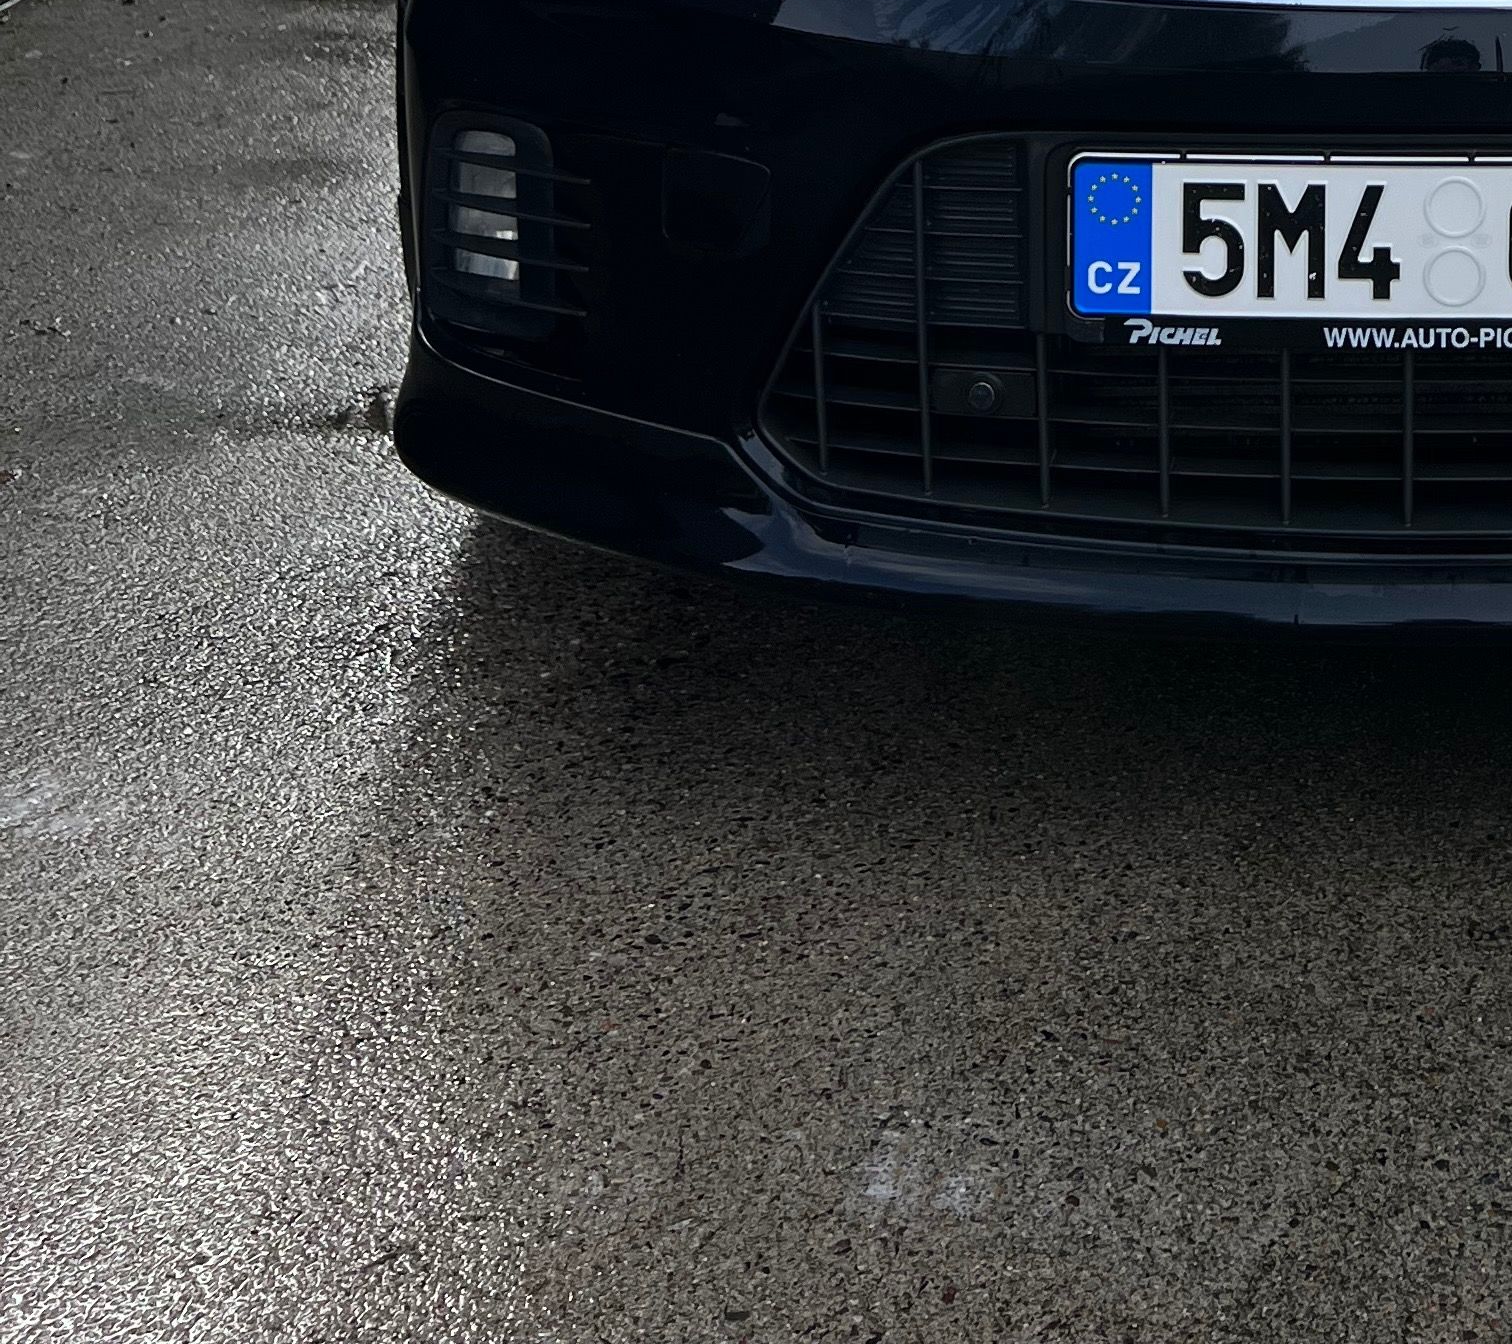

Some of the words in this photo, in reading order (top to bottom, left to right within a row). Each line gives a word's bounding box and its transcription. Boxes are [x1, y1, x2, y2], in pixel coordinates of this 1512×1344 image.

[1182, 181, 1401, 299] 5M4
[1087, 261, 1141, 295] CZ
[1123, 318, 1222, 346] PICHEL
